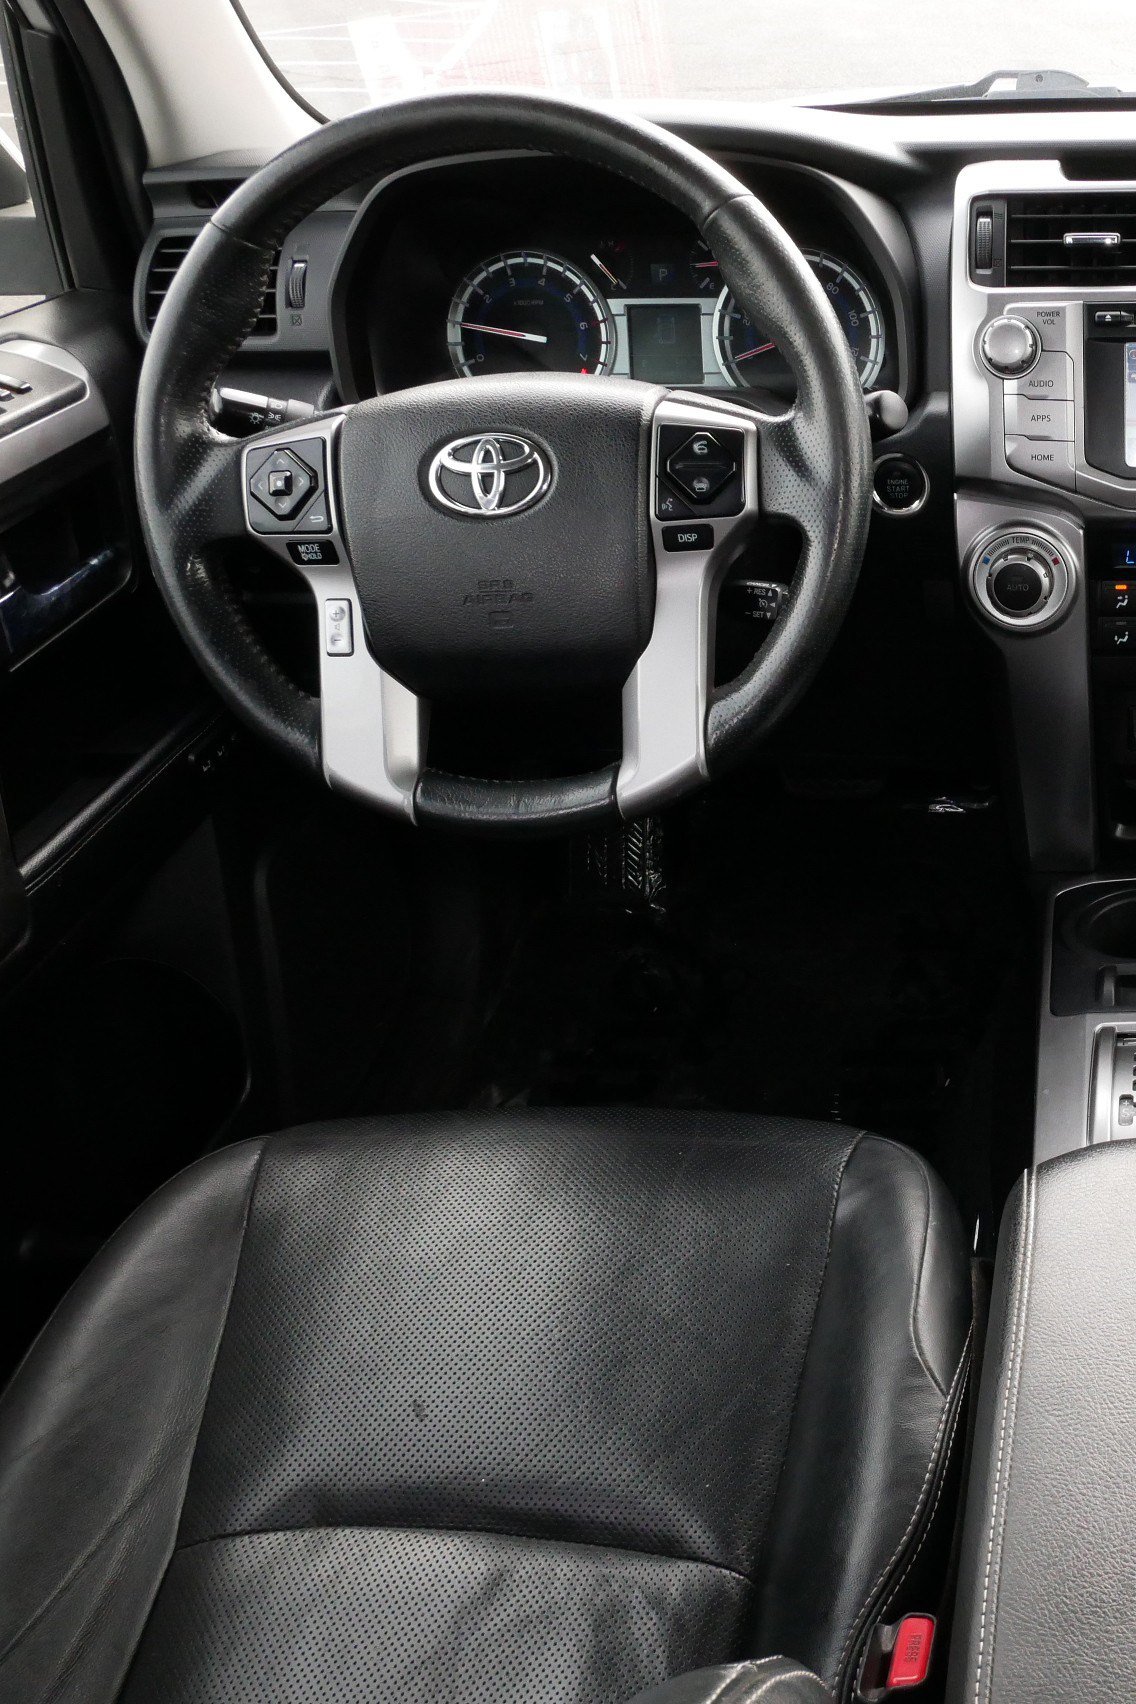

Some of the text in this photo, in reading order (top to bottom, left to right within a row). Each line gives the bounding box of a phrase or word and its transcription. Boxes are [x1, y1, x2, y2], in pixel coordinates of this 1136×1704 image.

[508, 277, 516, 287] 3
[537, 277, 546, 287] 4
[826, 282, 839, 295] 80
[482, 294, 494, 304] 2
[564, 294, 574, 303] 5
[847, 310, 860, 327] 100
[578, 322, 589, 330] 6
[476, 353, 486, 362] 0
[578, 353, 588, 362] 7
[678, 534, 698, 542] DISP
[298, 544, 321, 554] MODE
[1006, 584, 1030, 592] AUTO
